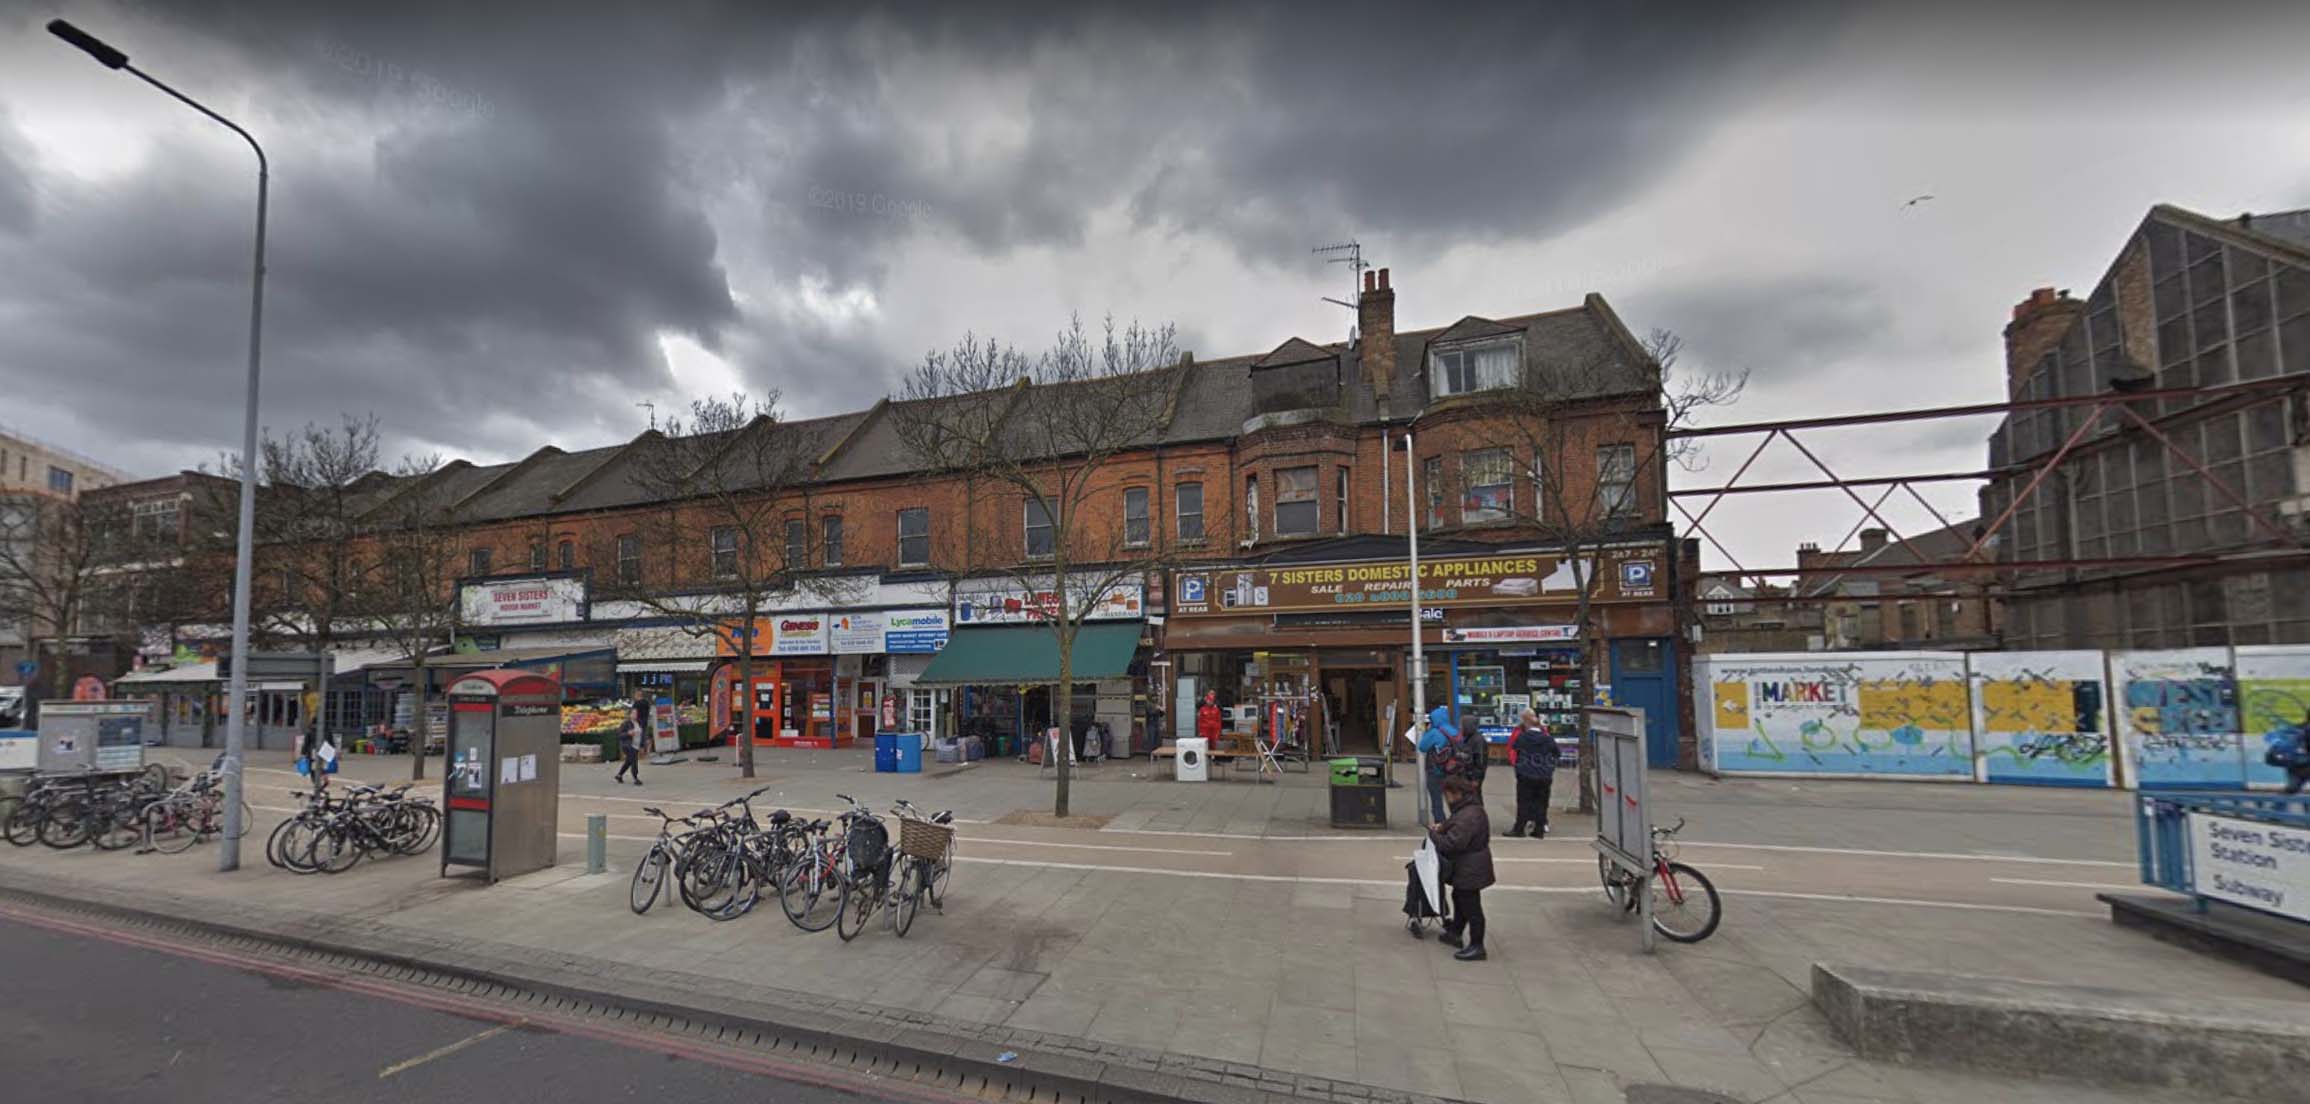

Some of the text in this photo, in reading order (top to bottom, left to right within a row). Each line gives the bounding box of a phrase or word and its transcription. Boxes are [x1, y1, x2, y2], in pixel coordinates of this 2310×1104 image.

[1269, 559, 1538, 584] 7 SISTERS DOMESTC APPLIANCES
[493, 590, 551, 603] SEVEN SISTERS
[1311, 584, 1343, 594] SALE
[1446, 578, 1490, 588] PARTS
[520, 602, 542, 610] MARKET
[891, 615, 943, 627] Lycamobile
[1762, 681, 1846, 703] MARKET
[2208, 821, 2263, 845] Seven
[2211, 842, 2277, 870] Station
[2213, 874, 2285, 907] Subway
